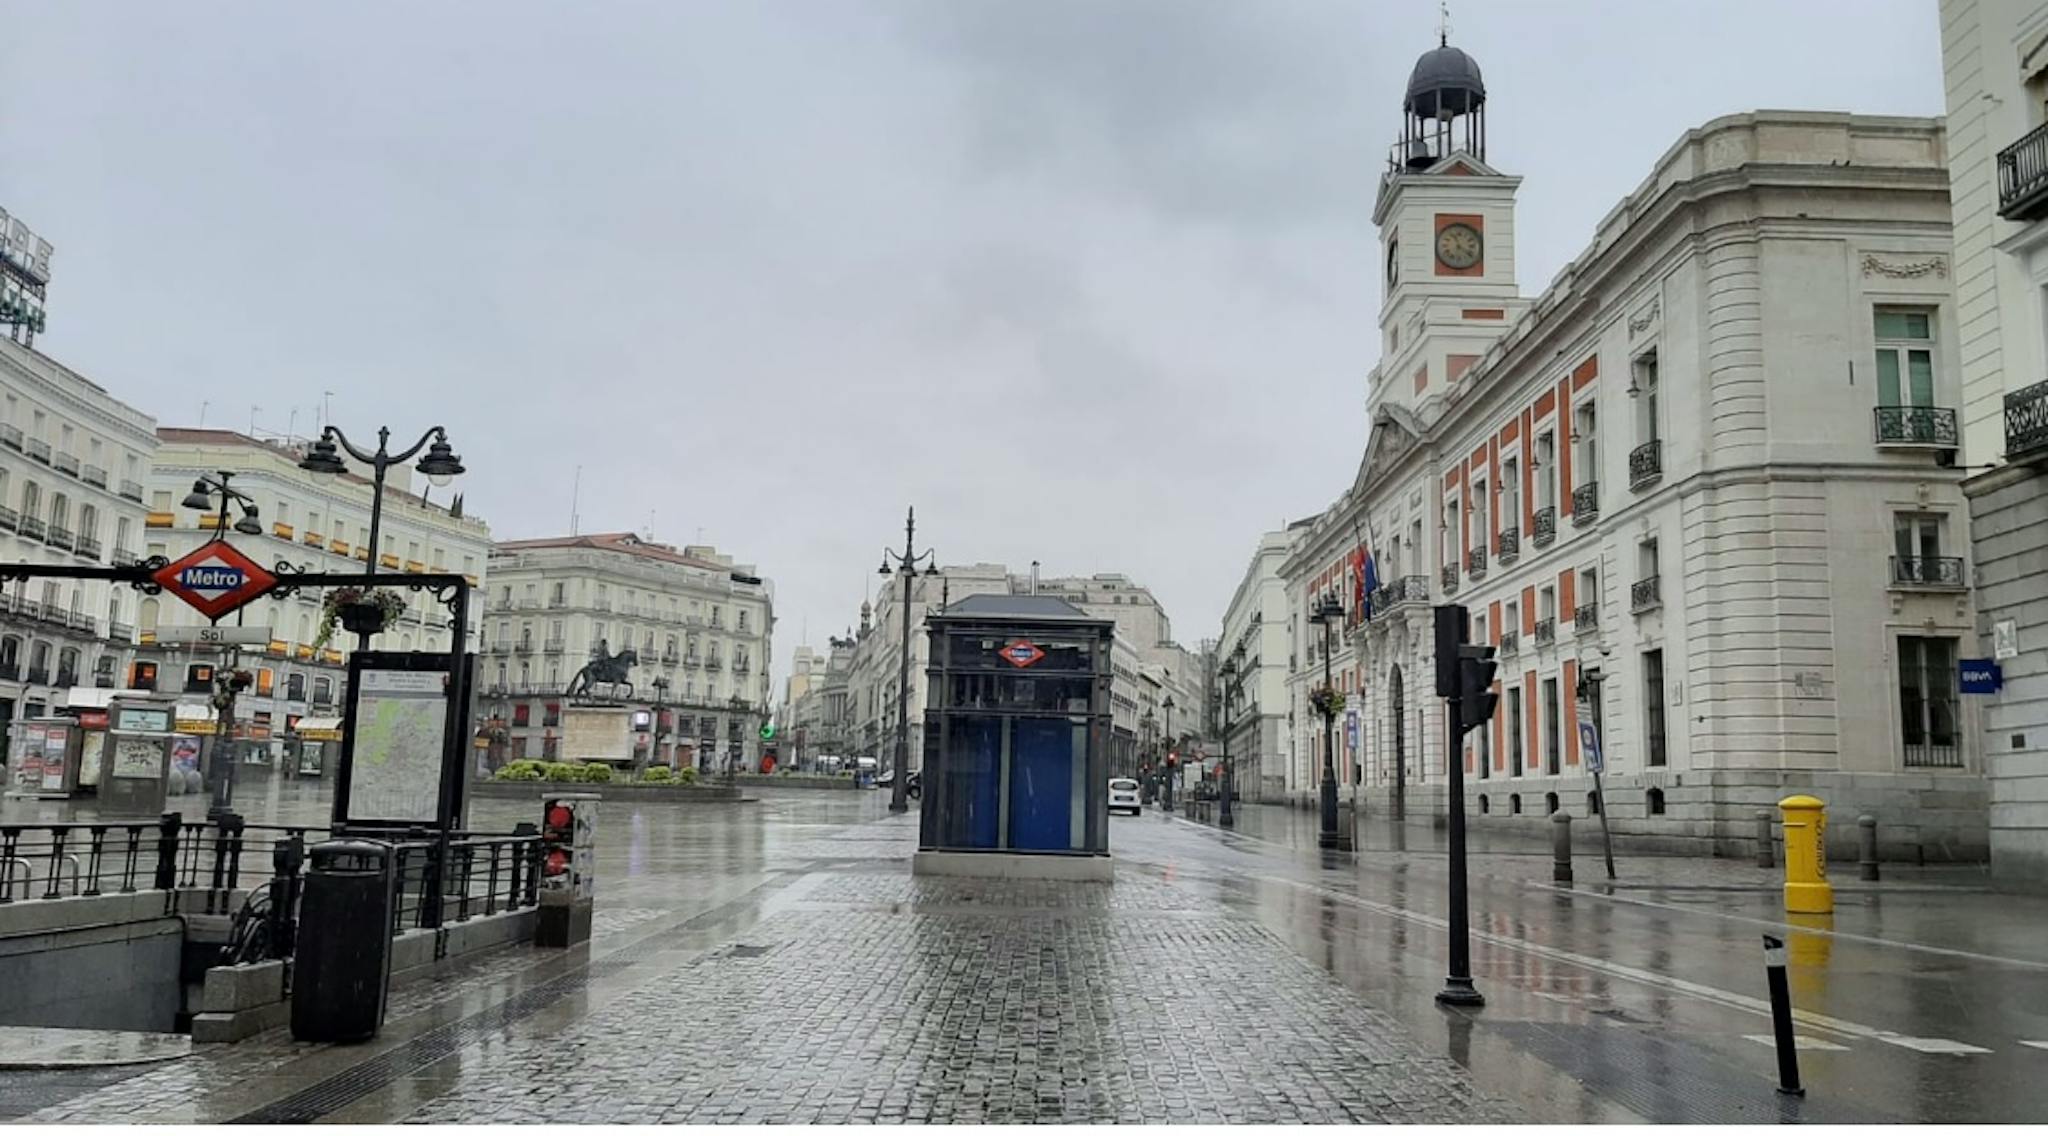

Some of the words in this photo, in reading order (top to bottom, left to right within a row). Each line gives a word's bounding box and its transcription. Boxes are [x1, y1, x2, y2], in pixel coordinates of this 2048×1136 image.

[186, 569, 238, 586] Metro
[200, 630, 224, 641] Sol
[1962, 670, 1992, 682] BBVA
